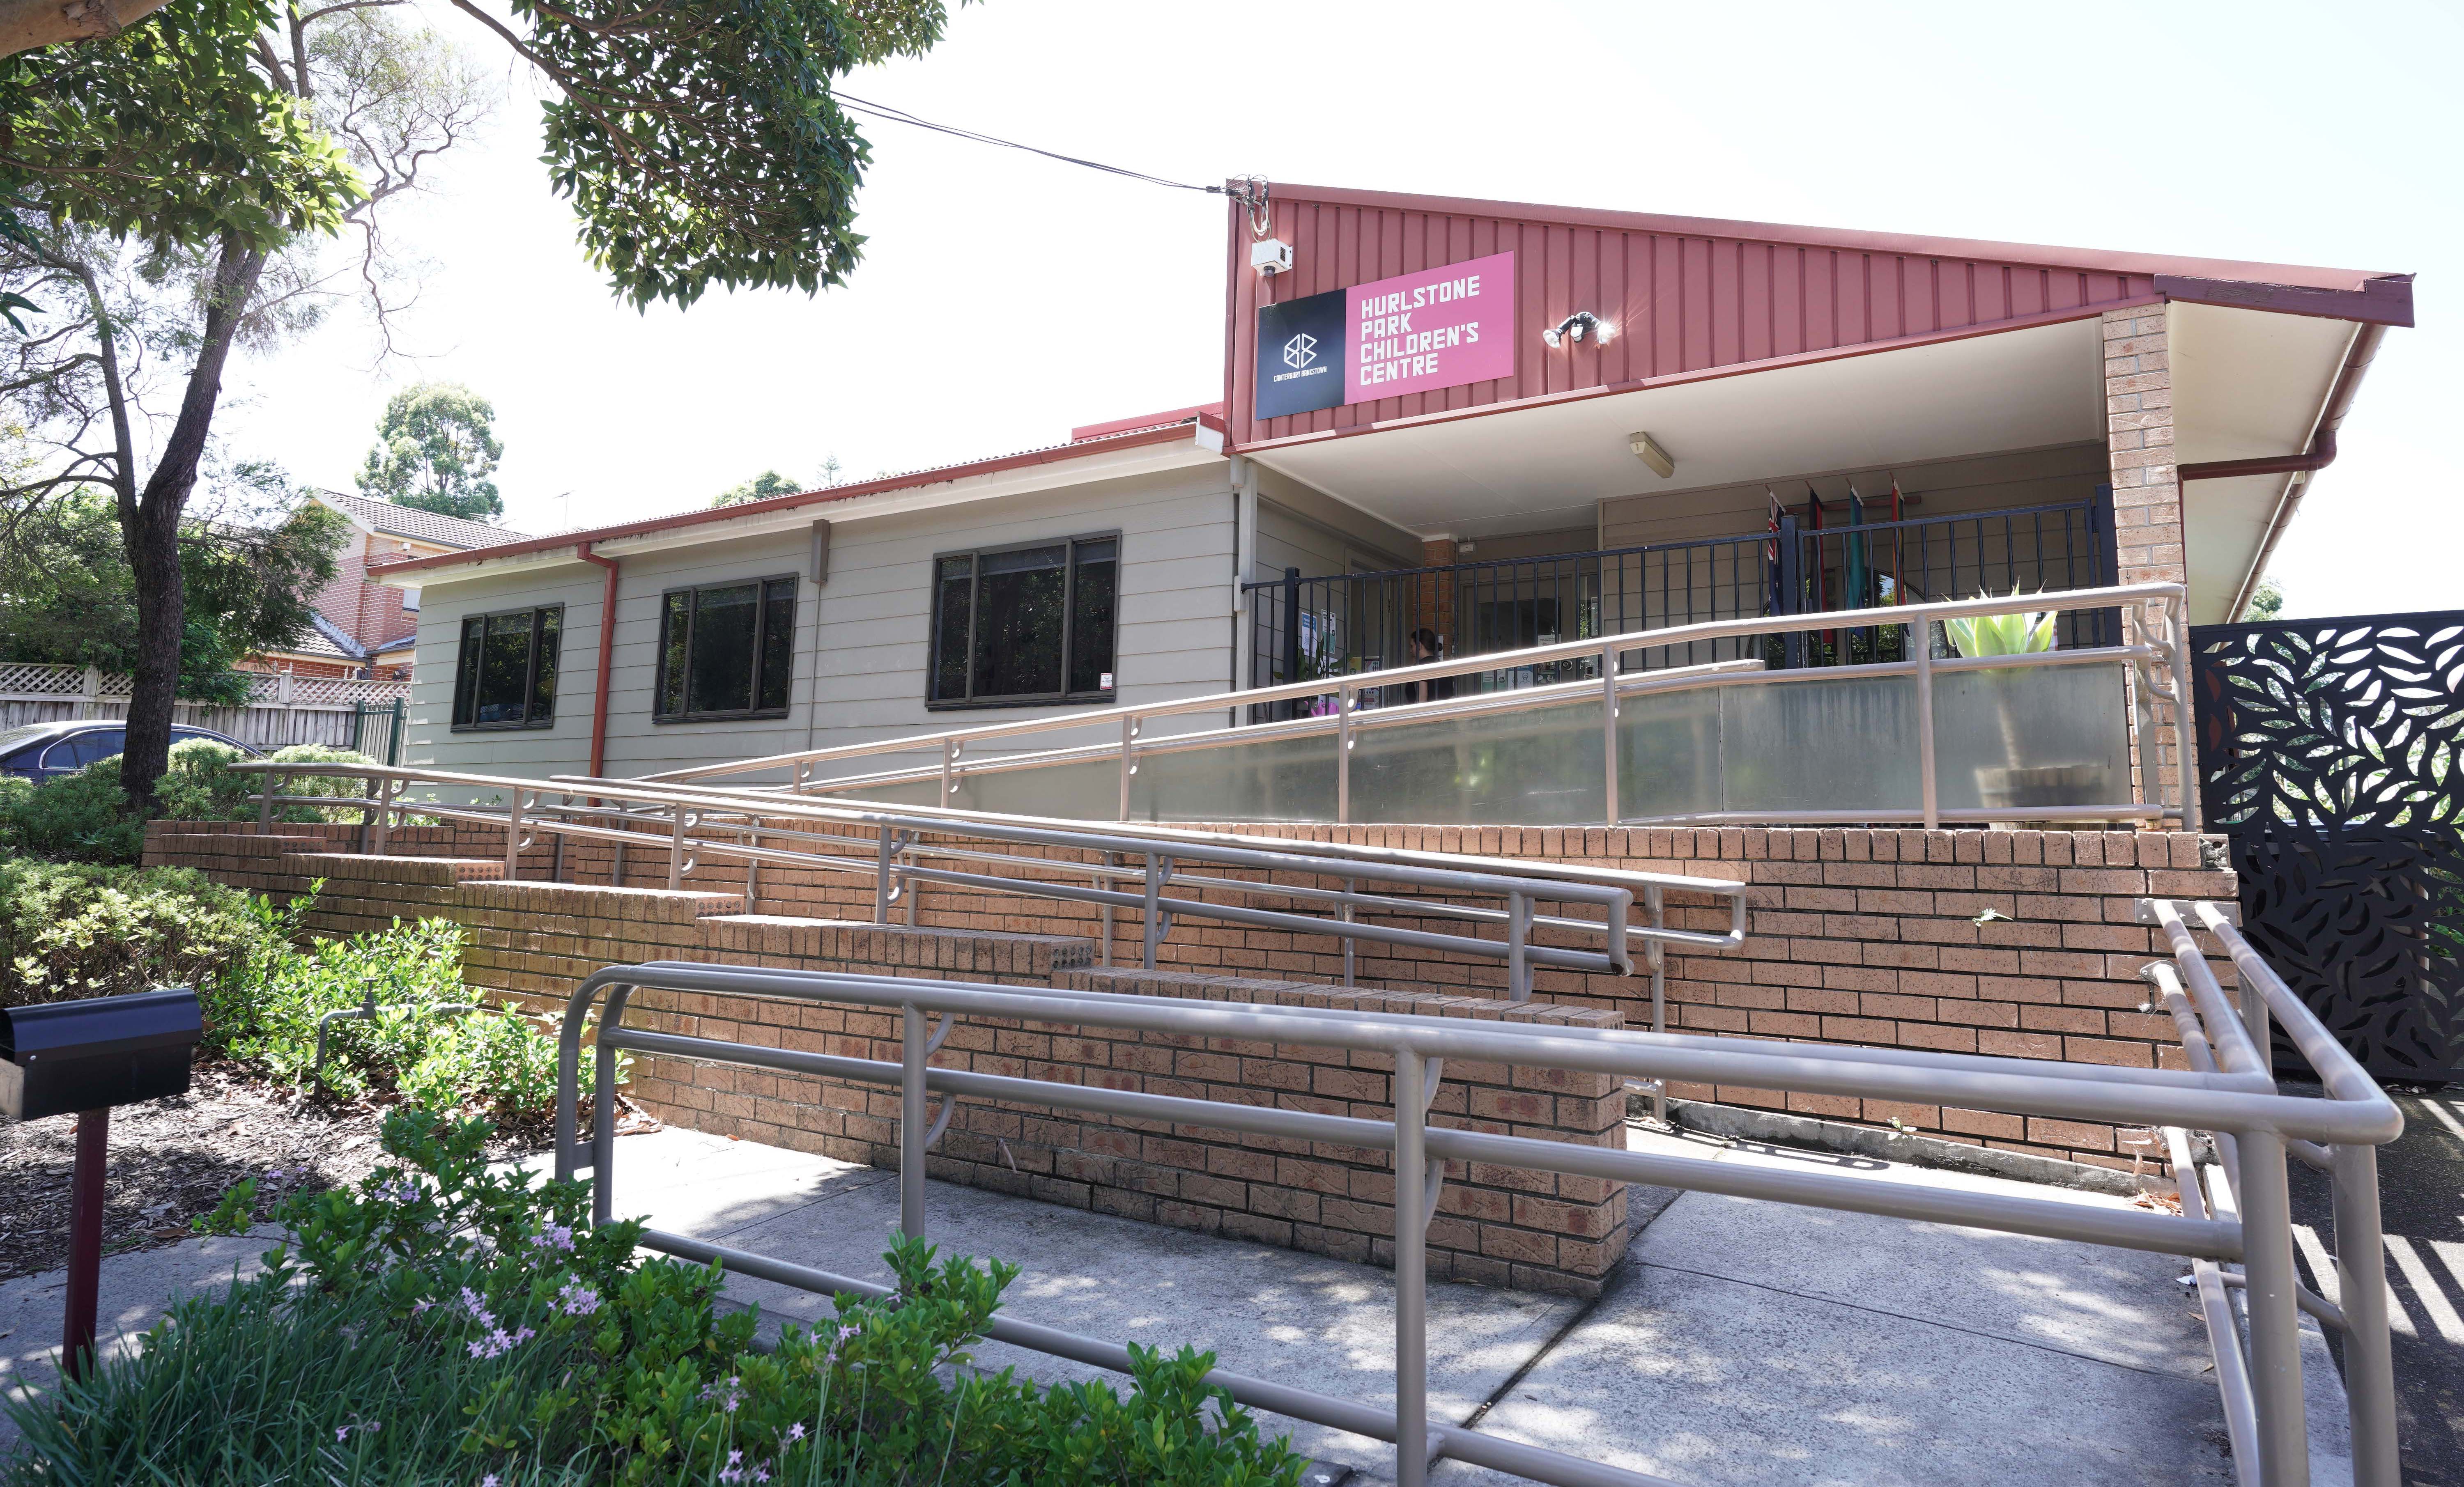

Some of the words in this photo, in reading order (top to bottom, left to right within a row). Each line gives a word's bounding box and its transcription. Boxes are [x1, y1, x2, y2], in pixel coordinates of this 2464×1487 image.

[1361, 275, 1480, 319] HURLSTONE
[1361, 312, 1412, 342] PARK
[1361, 321, 1479, 363] CHILDREN'S
[1273, 371, 1301, 382] CANTERBURY
[1301, 366, 1327, 377] BANKSTOWN
[1360, 352, 1438, 386] CENTRE
